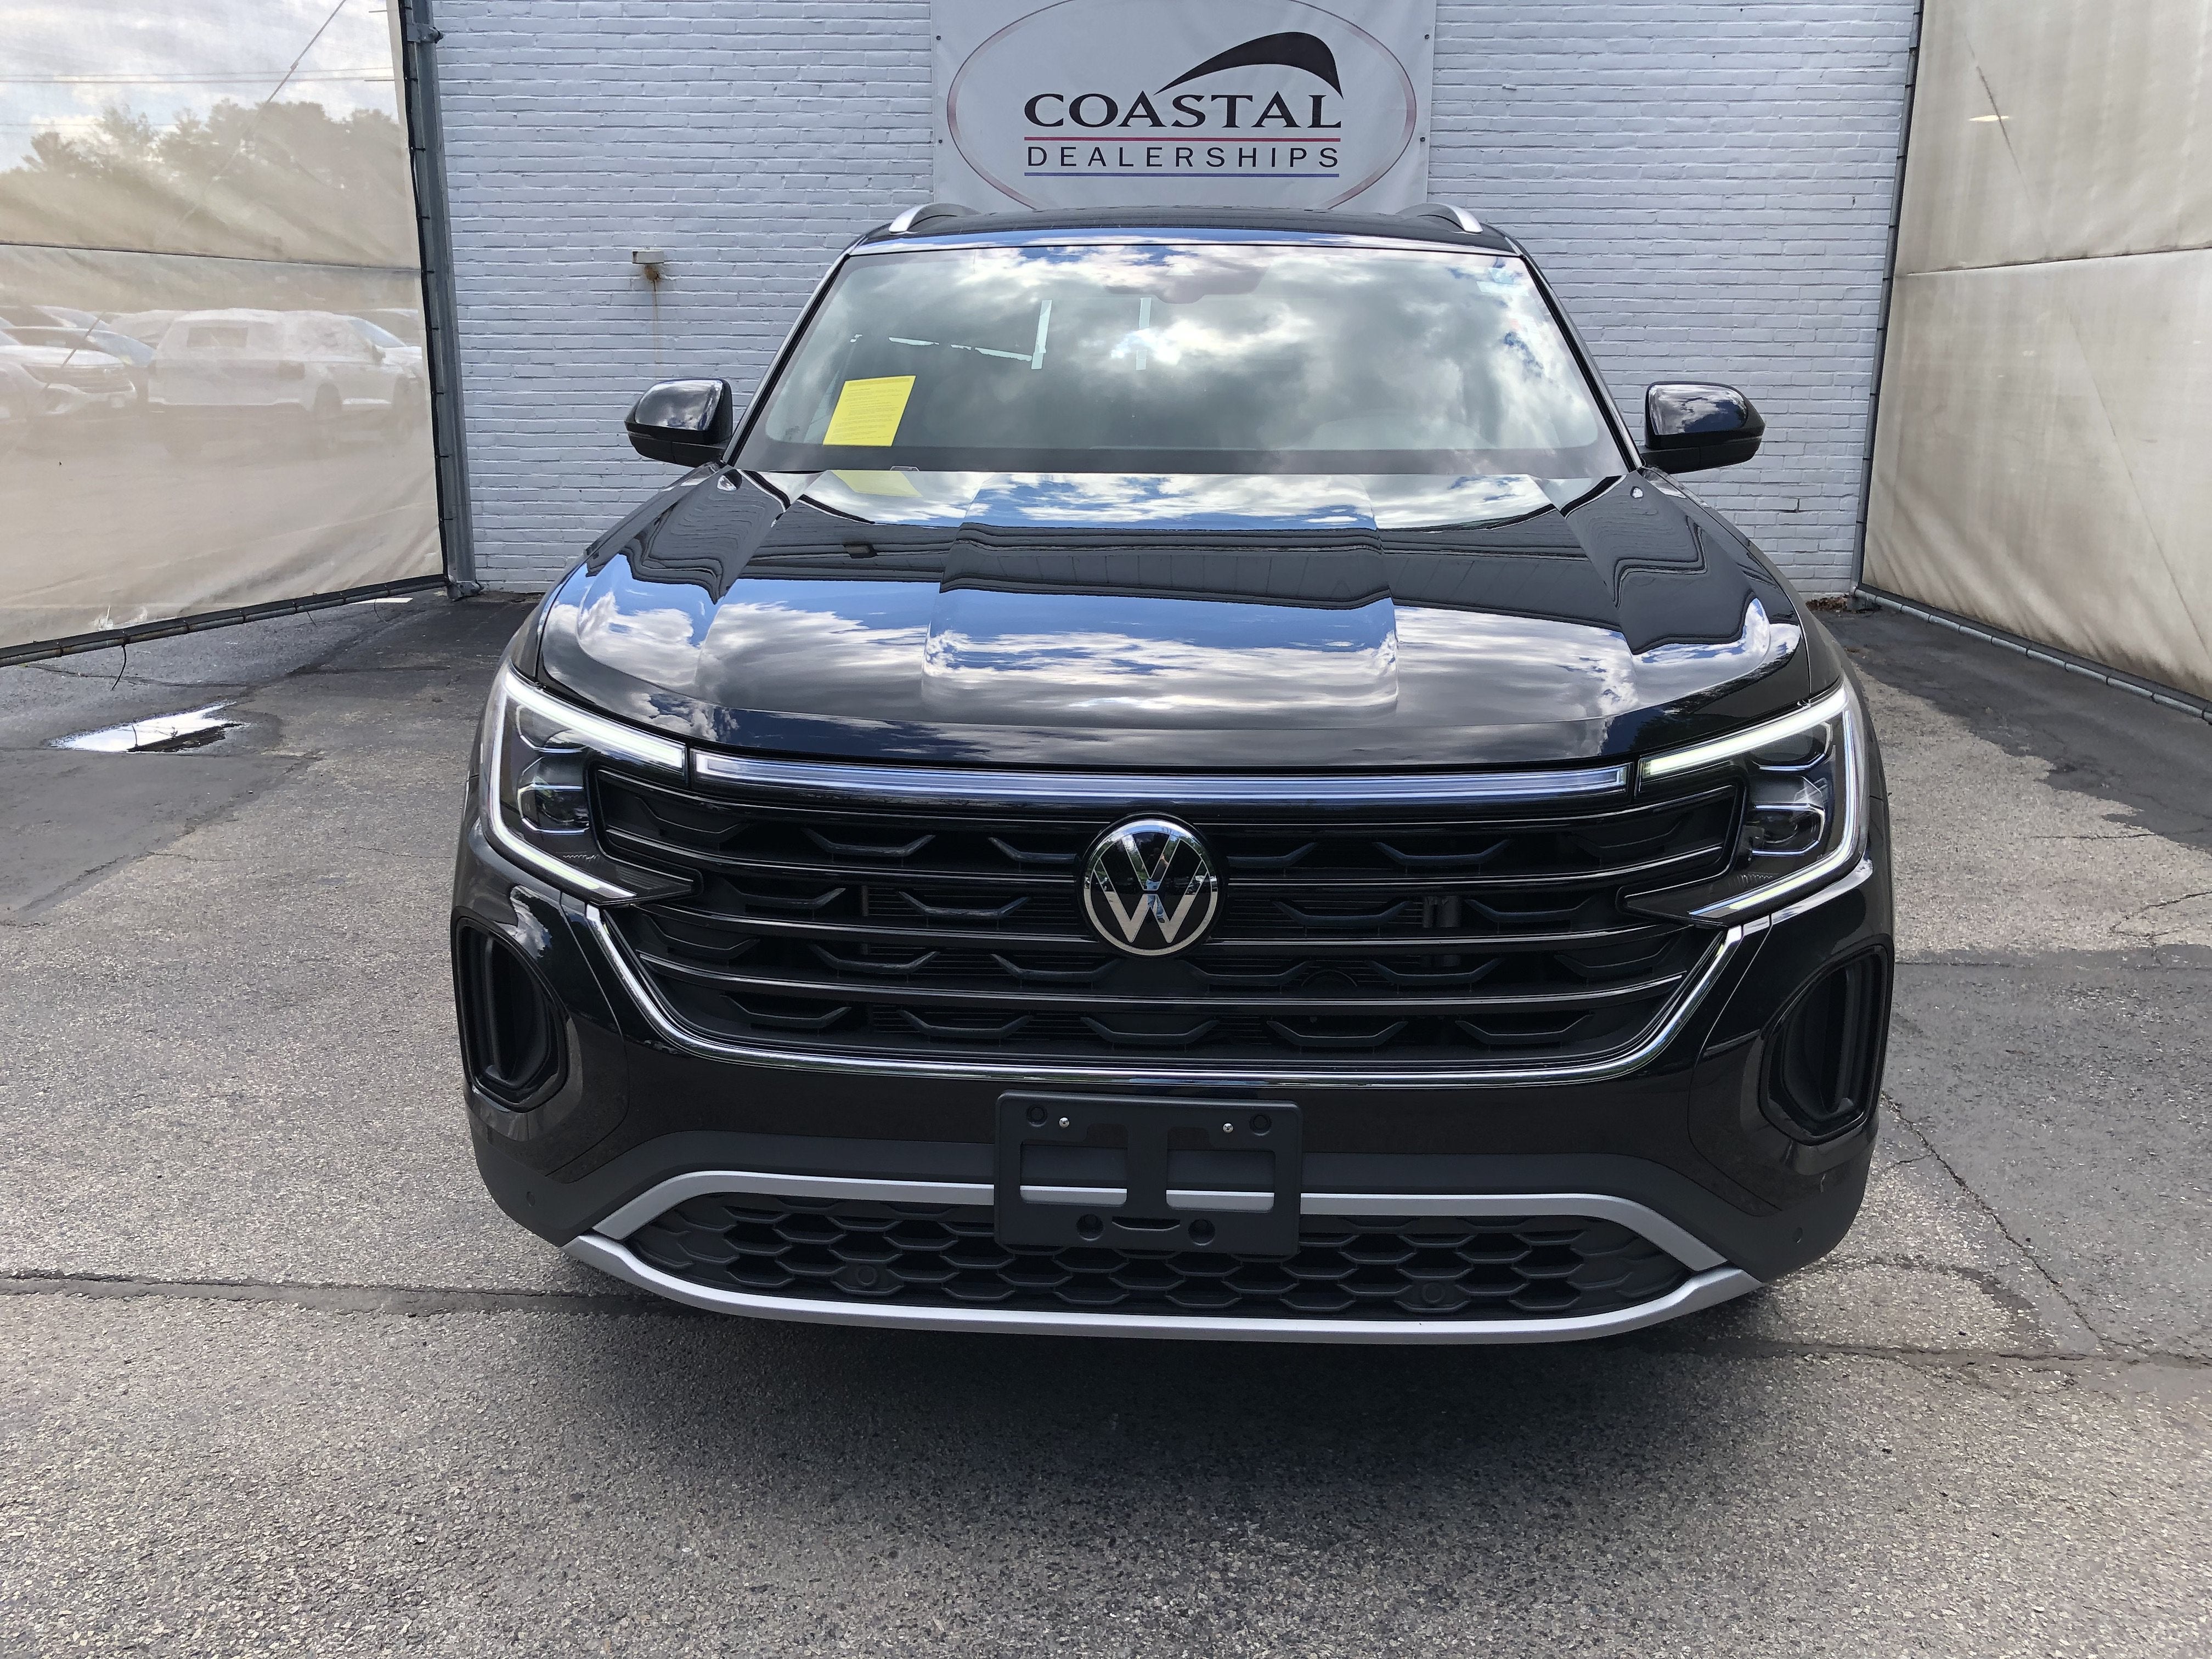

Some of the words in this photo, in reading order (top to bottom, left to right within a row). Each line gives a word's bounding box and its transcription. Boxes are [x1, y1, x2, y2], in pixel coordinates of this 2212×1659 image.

[1024, 91, 1342, 128] COASTAL
[1028, 146, 1338, 168] DEALERSHIPS
[1091, 832, 1211, 945] VW
